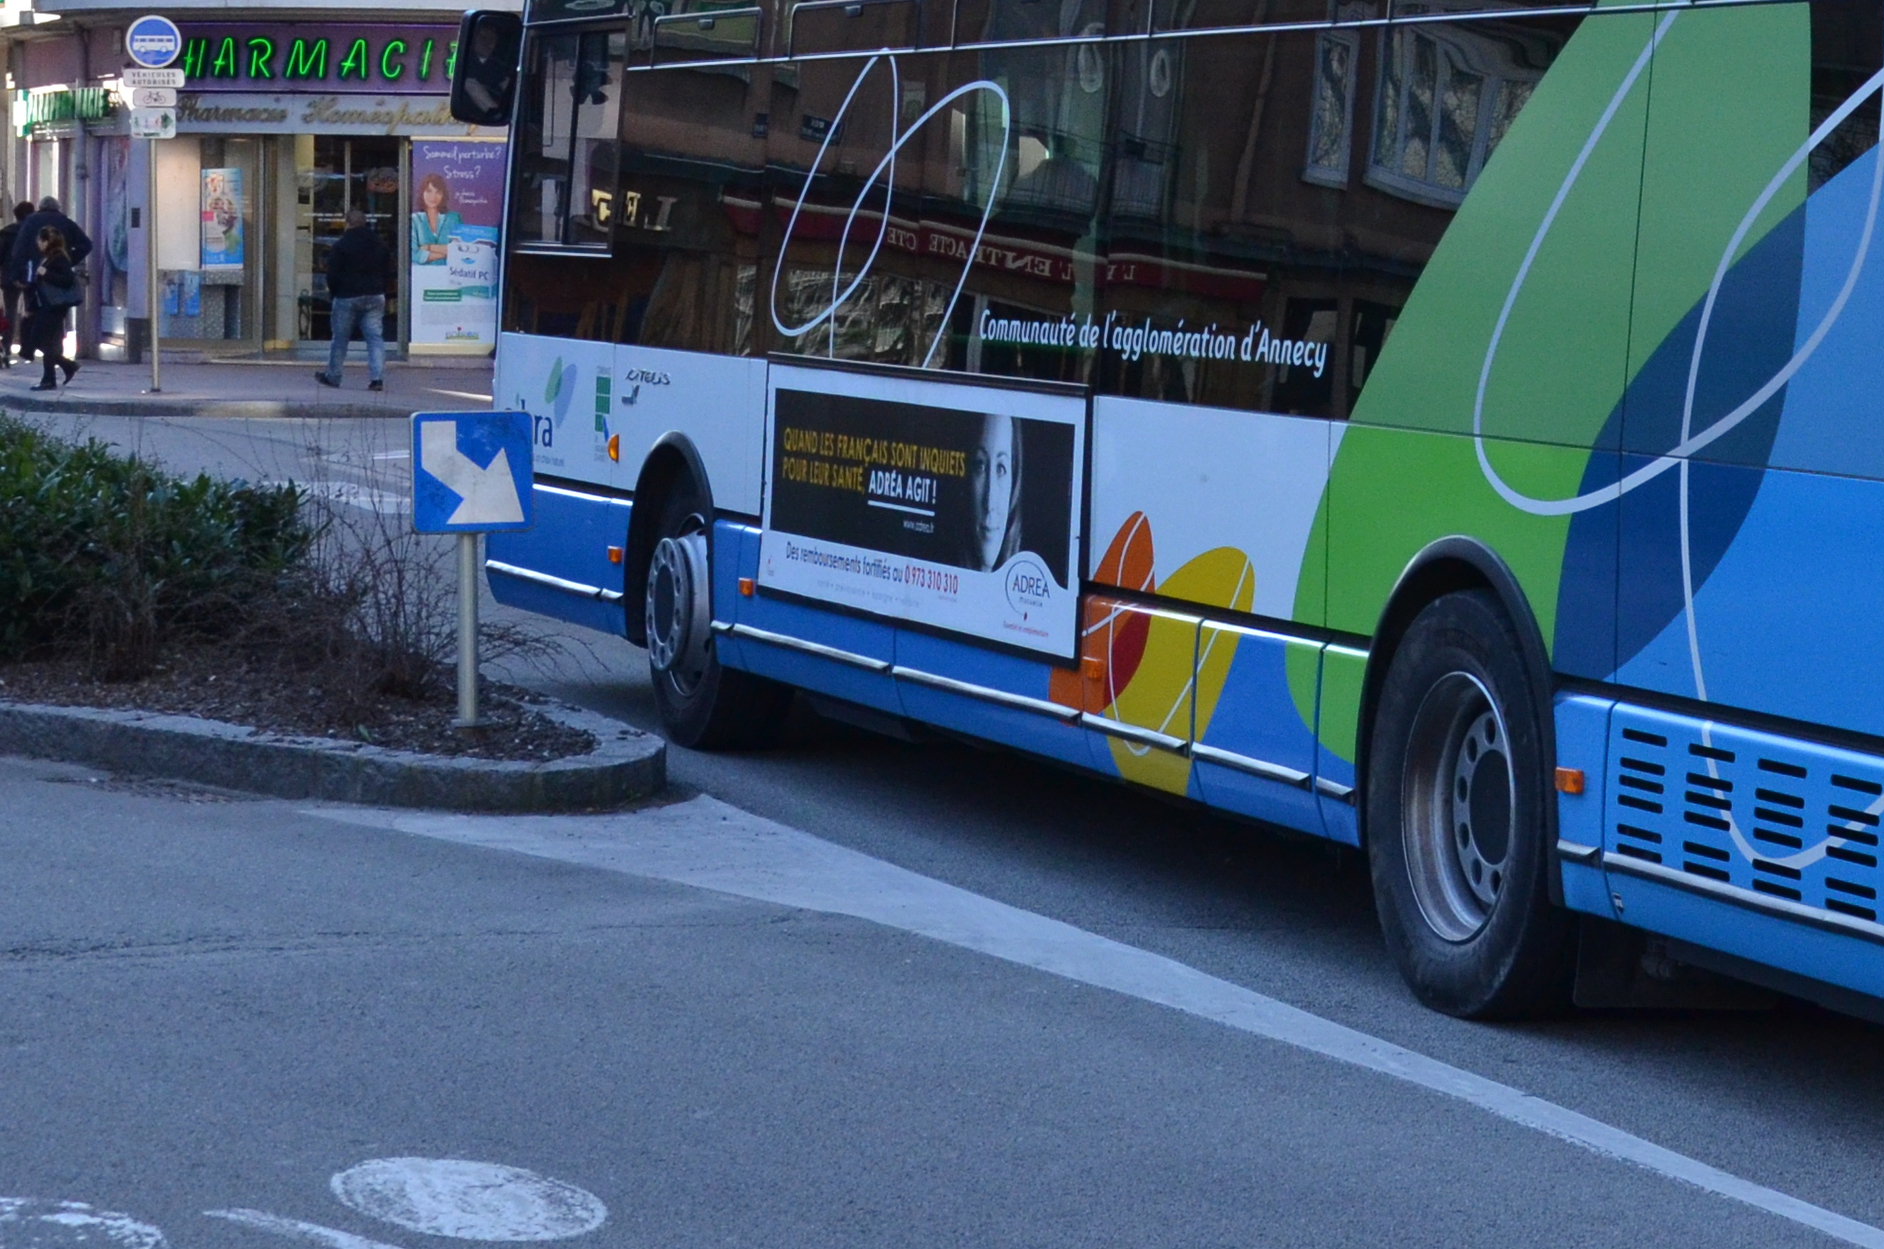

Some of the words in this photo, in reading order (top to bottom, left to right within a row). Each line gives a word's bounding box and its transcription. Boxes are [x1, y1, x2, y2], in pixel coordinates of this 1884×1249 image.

[979, 308, 1076, 348] Communauté
[1079, 314, 1099, 348] de
[1103, 309, 1236, 362] l'agglomération
[1241, 319, 1328, 378] d'Annecy
[784, 427, 818, 453] QUAND
[820, 432, 835, 456] LES
[837, 433, 889, 467] FRANÇAIS
[891, 441, 918, 470] SONT
[919, 446, 967, 478] INQUIETS
[782, 456, 807, 482] POUR
[809, 460, 831, 486] LEUR
[867, 469, 902, 500] ADRÉA
[905, 474, 931, 503] AGIT
[785, 541, 799, 561] Des
[799, 546, 861, 574] remboursements
[861, 556, 891, 581] fortifiés
[892, 566, 903, 583] au
[904, 564, 911, 585] 0
[912, 565, 926, 588] 973
[926, 569, 942, 591] 310
[942, 572, 959, 595] 310
